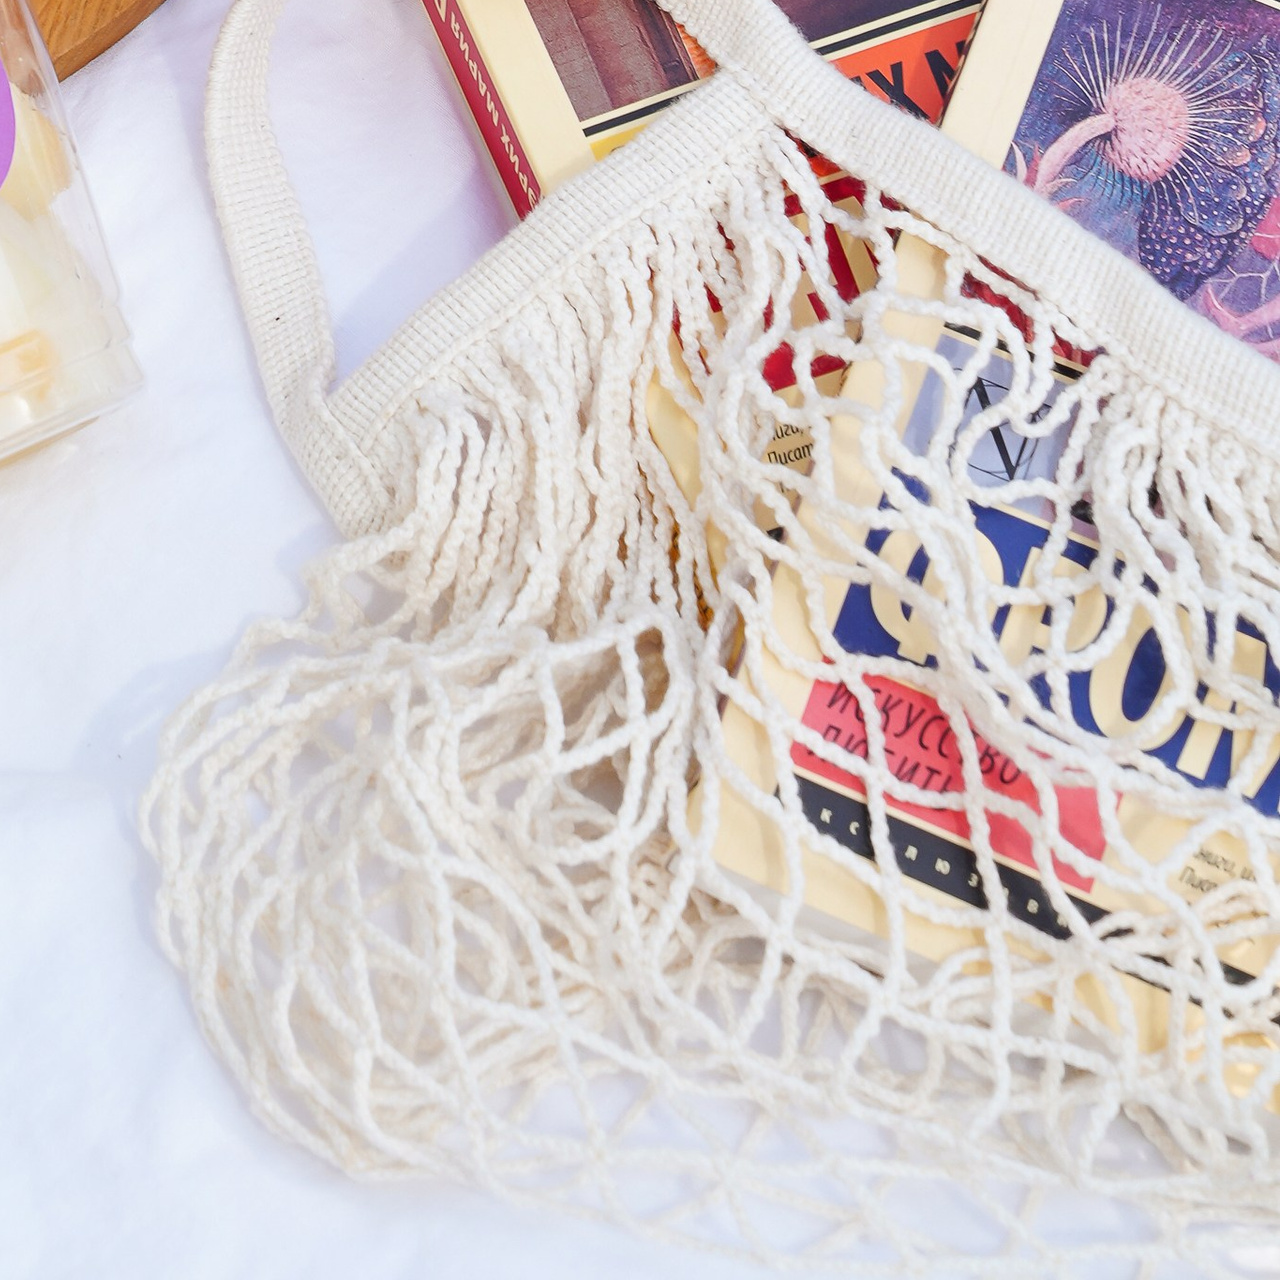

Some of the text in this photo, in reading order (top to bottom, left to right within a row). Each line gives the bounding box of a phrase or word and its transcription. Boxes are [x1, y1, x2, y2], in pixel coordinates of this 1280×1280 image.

[450, 11, 500, 127] МАРИЯ
[501, 123, 536, 211] ЭРИХ
[826, 680, 1022, 784] ИСКУССВО
